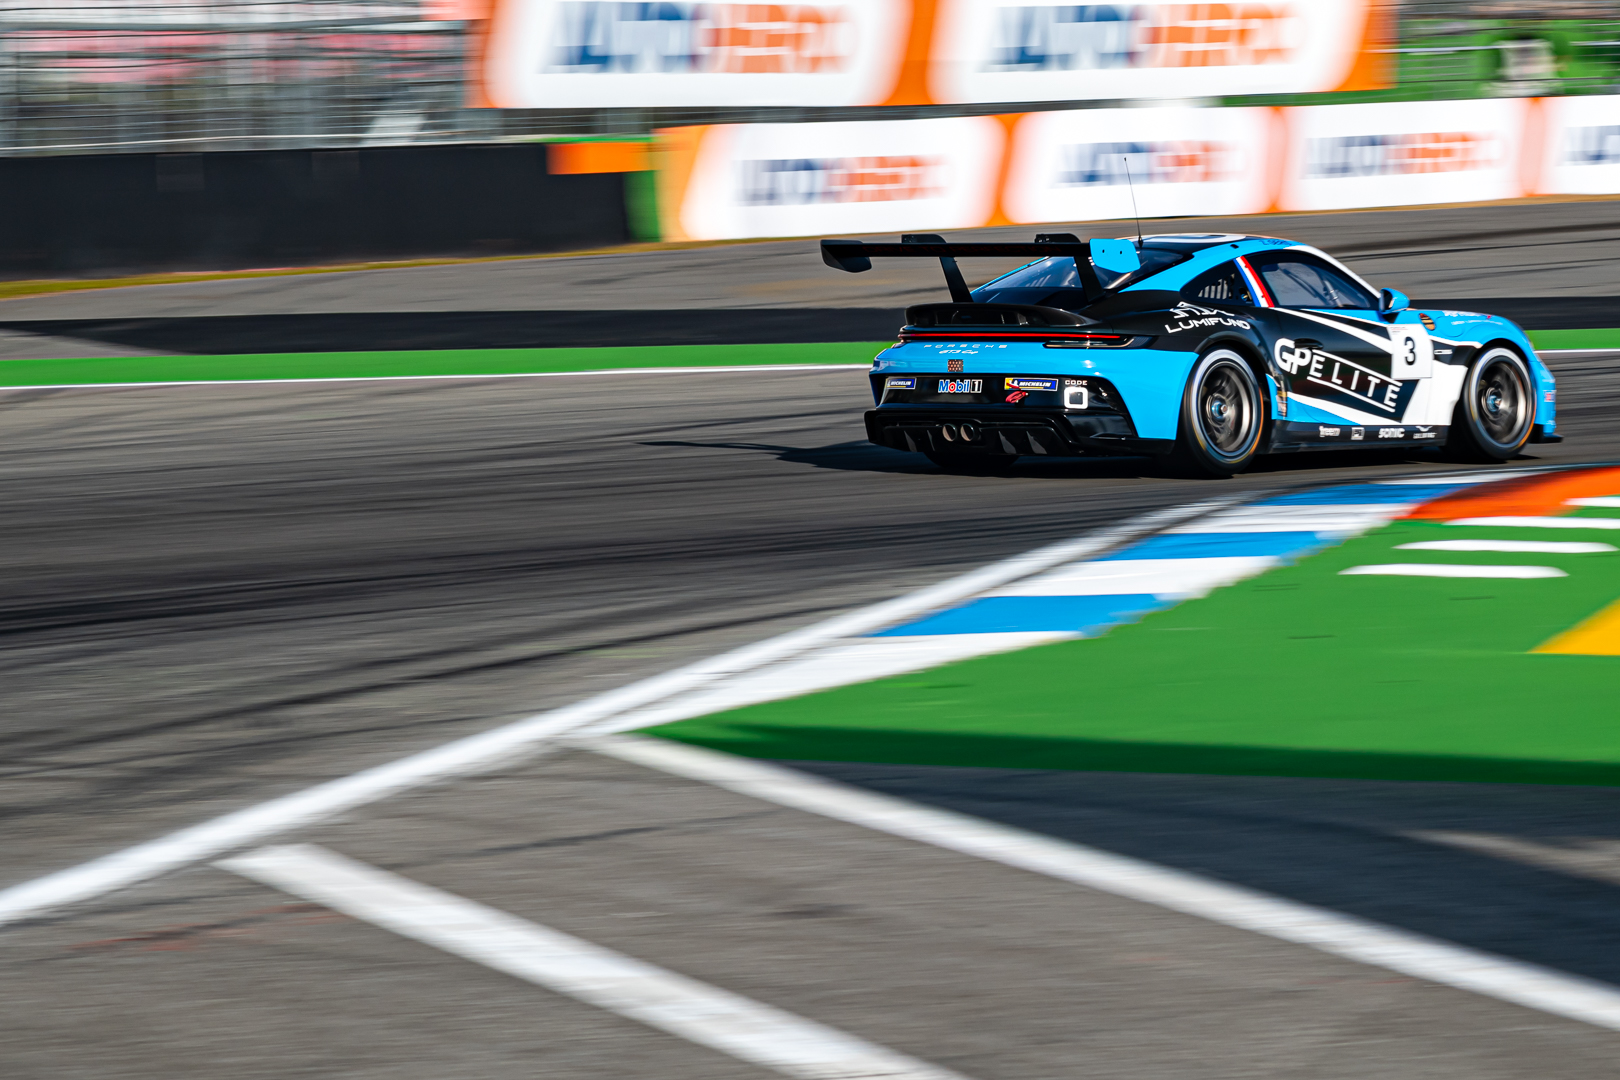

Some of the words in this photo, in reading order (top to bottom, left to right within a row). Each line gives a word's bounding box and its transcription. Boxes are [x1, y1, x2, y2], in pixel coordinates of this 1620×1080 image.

[1164, 317, 1251, 334] LUMIFUND
[1404, 336, 1416, 366] 3
[938, 379, 970, 393] Mobil
[1308, 354, 1401, 408] ELITE
